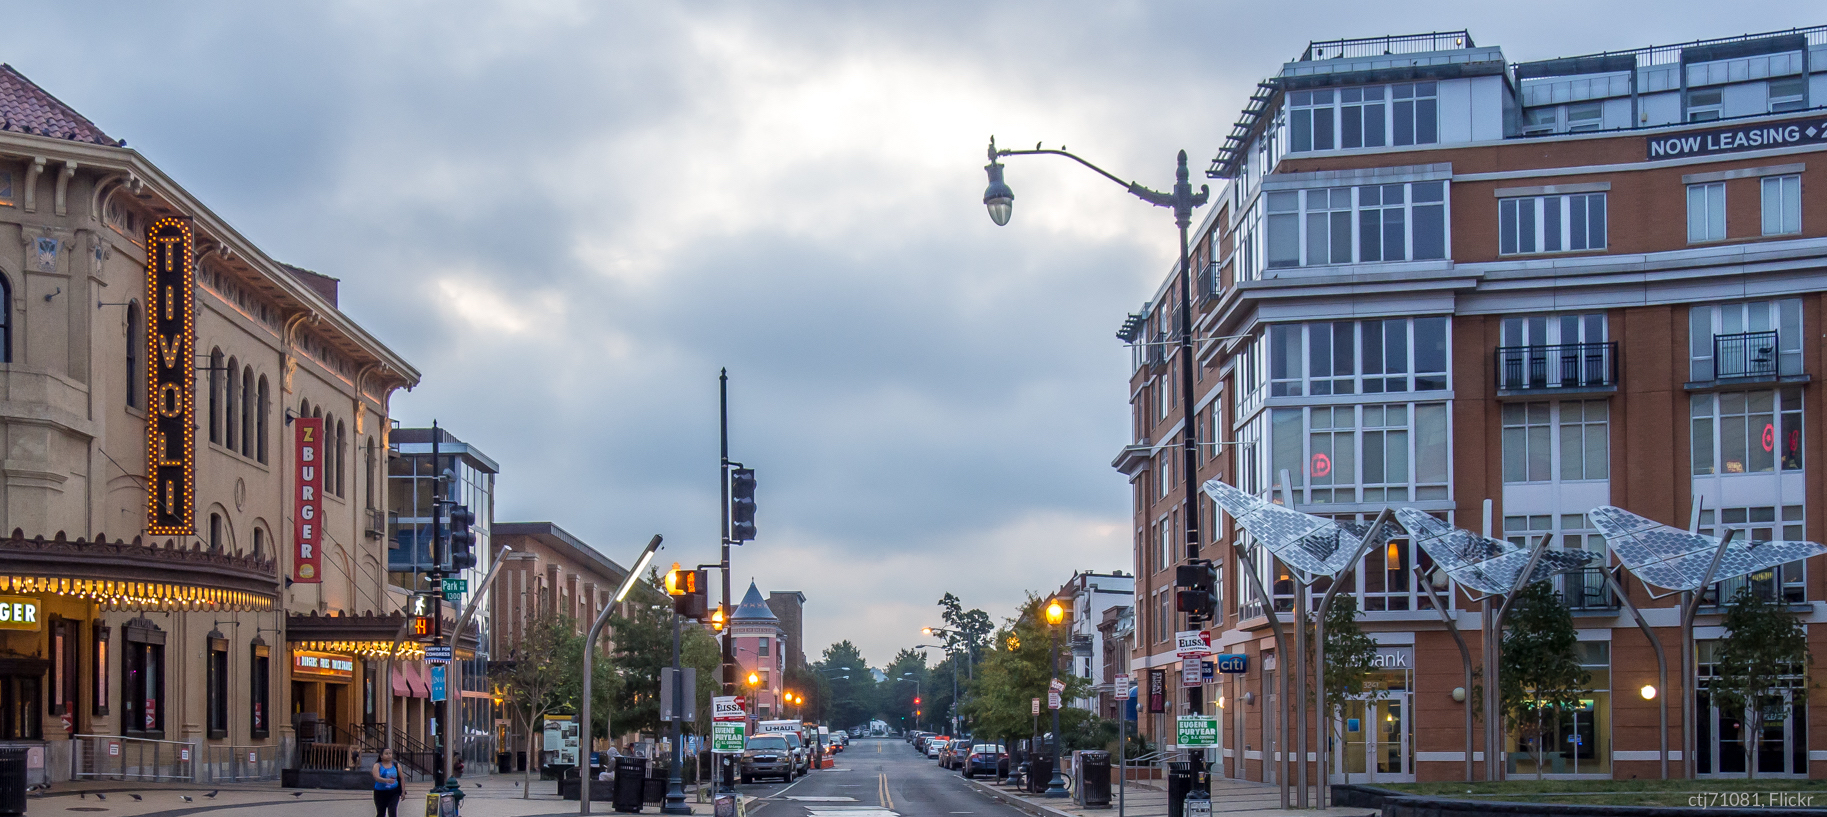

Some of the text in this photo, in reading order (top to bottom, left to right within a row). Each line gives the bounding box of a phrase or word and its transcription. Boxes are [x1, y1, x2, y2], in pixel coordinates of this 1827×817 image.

[1651, 136, 1701, 157] NOW
[1707, 126, 1800, 151] LEASING
[158, 235, 183, 516] TIVOLI
[301, 427, 314, 559] Z BURGER
[442, 580, 458, 591] Park
[447, 592, 461, 600] 1300
[0, 602, 36, 623] GER
[1179, 638, 1209, 648] ELISSA
[1220, 659, 1243, 671] citi
[716, 703, 743, 712] ELISSA
[715, 733, 742, 741] PURYEAR
